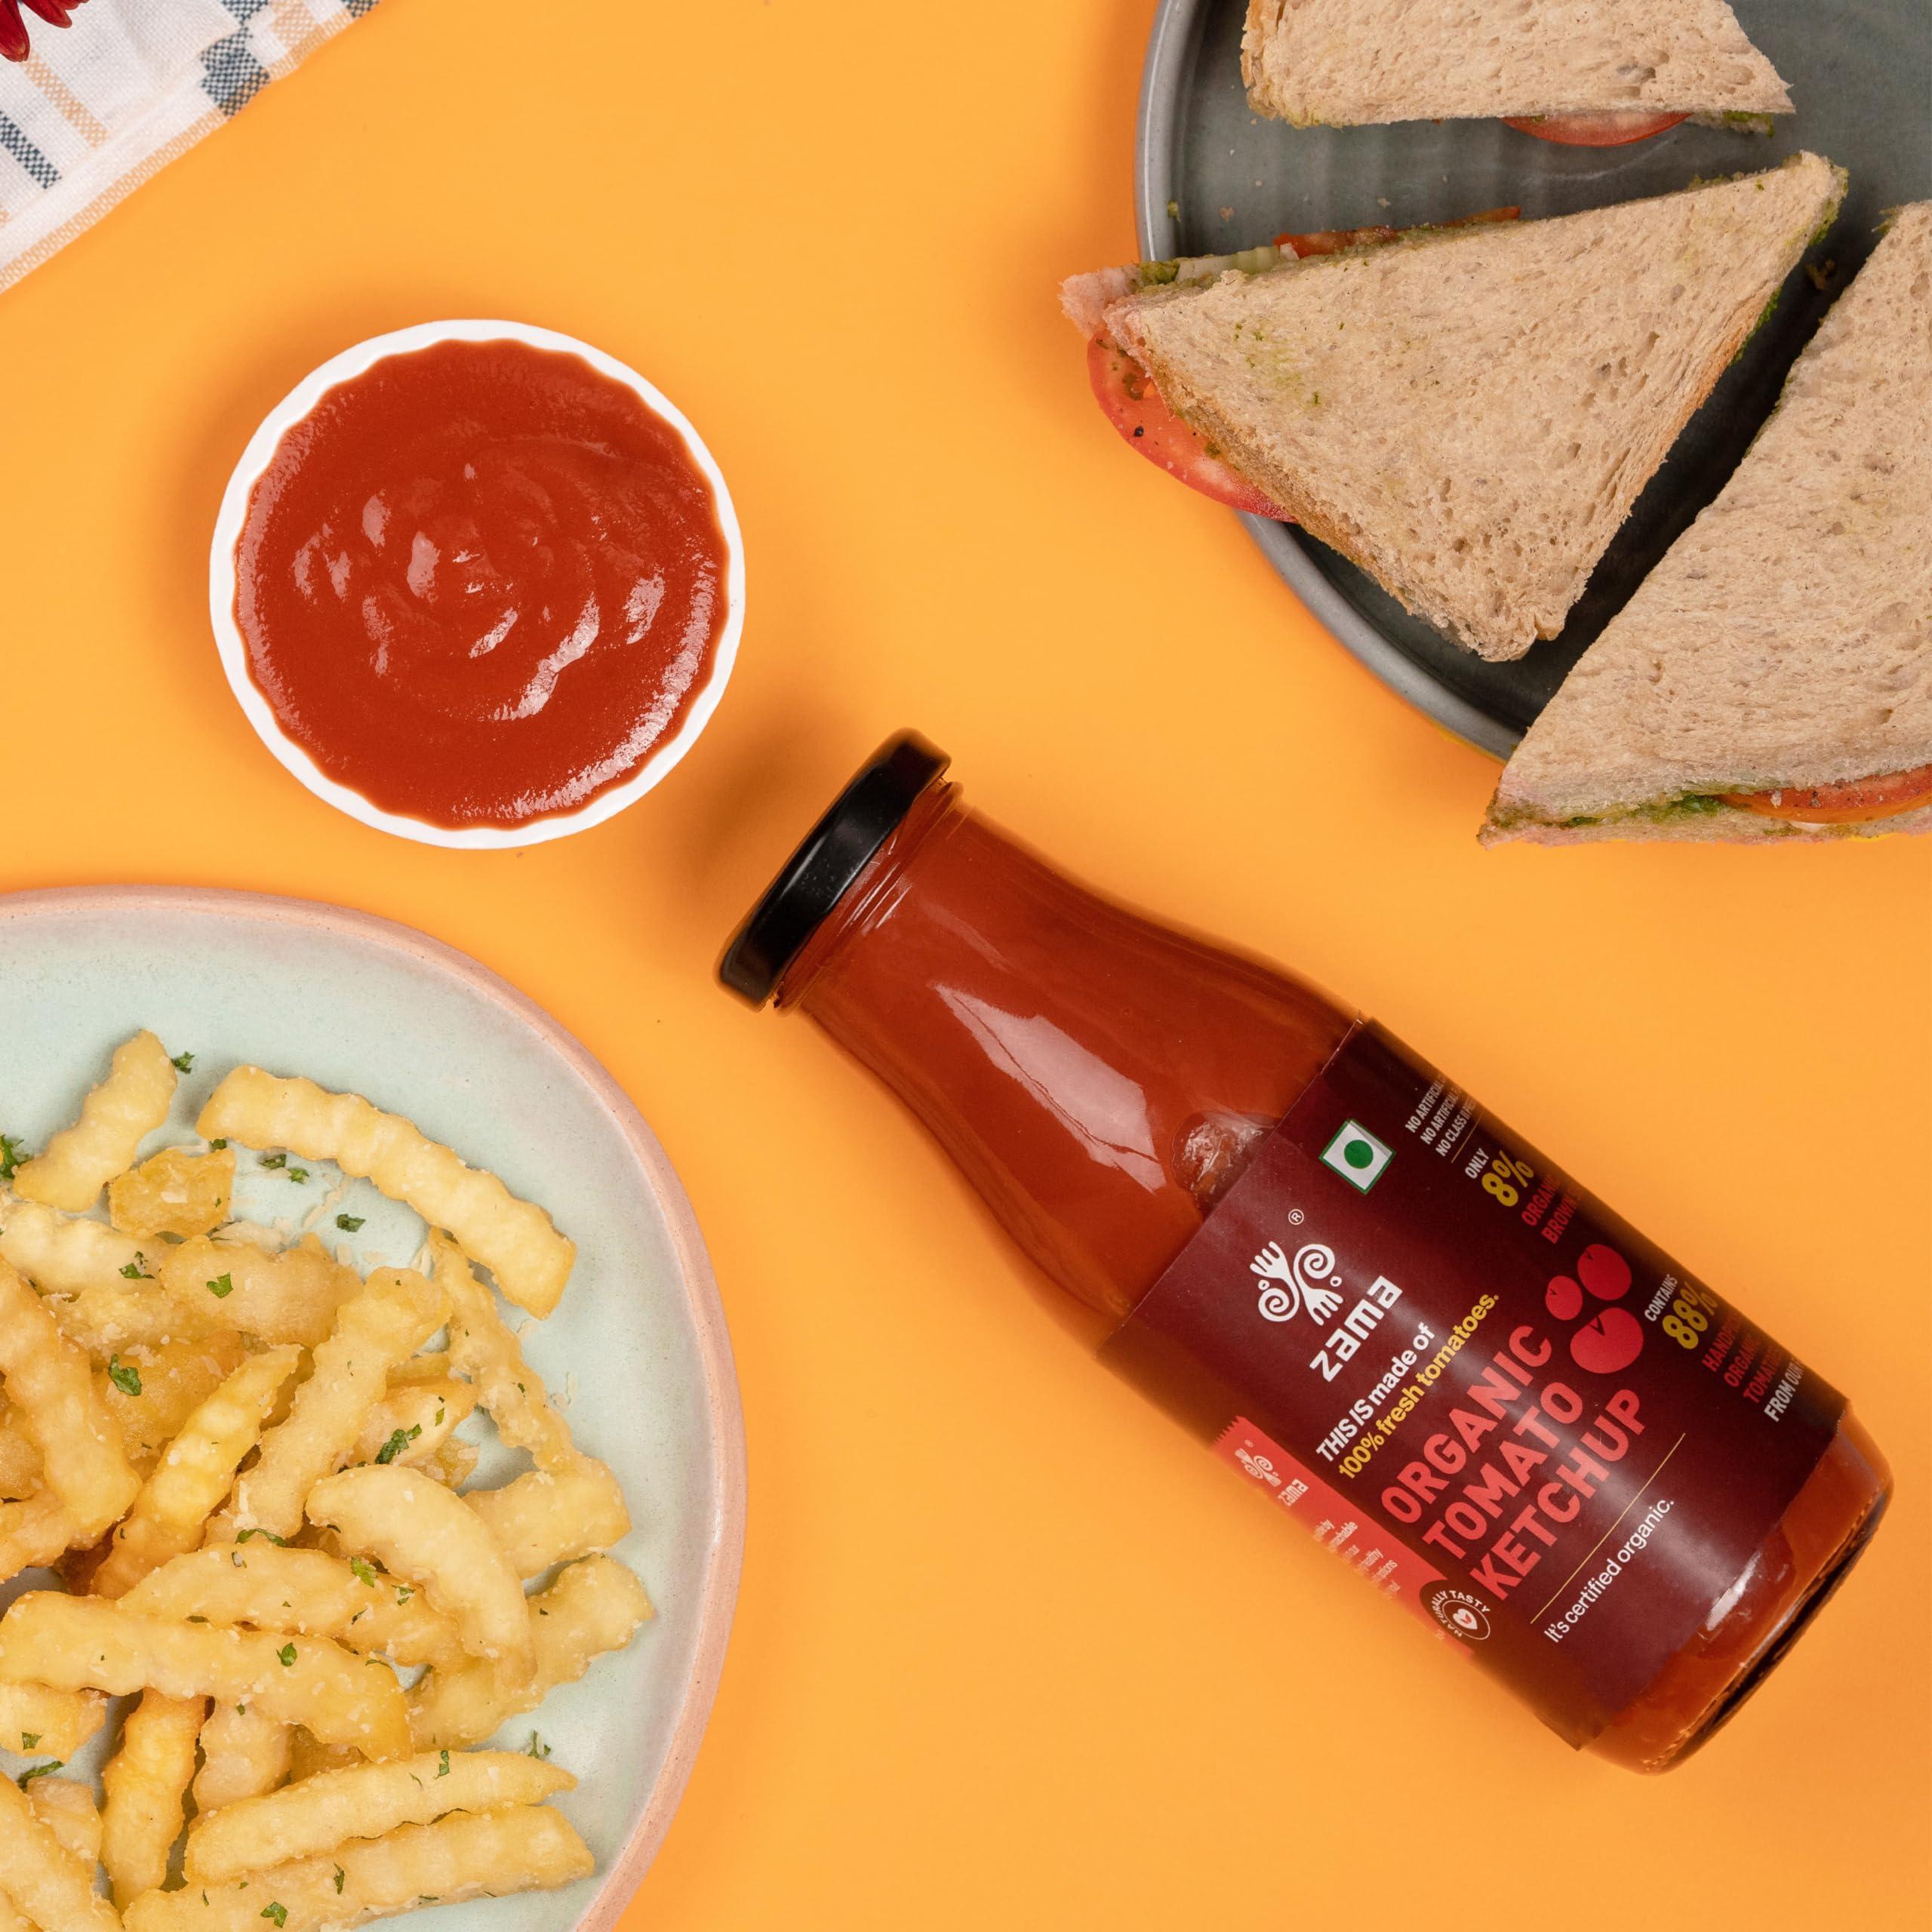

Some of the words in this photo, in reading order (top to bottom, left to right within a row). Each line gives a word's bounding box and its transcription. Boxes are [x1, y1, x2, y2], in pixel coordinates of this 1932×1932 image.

[1404, 1115, 1422, 1134] NO
[1416, 1079, 1445, 1121] ARTIFICIAL
[1420, 1127, 1437, 1146] NO
[1432, 1091, 1460, 1133] ARTIFICIAL
[1435, 1139, 1453, 1157] NO
[1447, 1115, 1469, 1143] CLASS
[1464, 1147, 1489, 1180] ONLY
[1481, 1149, 1534, 1207] 8%
[1644, 1273, 1678, 1321] CONTAINS
[1662, 1281, 1719, 1349] 88%
[1309, 1275, 1404, 1383] zama
[1315, 1418, 1358, 1462] THIS
[1349, 1398, 1374, 1426] IS
[1367, 1349, 1417, 1406] made
[1413, 1321, 1435, 1351] of
[1339, 1432, 1385, 1479] 100%
[1375, 1384, 1425, 1436] fresh
[1415, 1294, 1500, 1387] tomatoes.
[1763, 1379, 1797, 1423] FROM
[1784, 1360, 1804, 1386] OUR
[1381, 1325, 1552, 1524] ORGANIC
[1277, 1478, 1309, 1507] zama
[1422, 1381, 1583, 1560] TOMATO
[1469, 1389, 1645, 1601] KETCHUP
[1448, 1589, 1491, 1613] TASTY
[1544, 1620, 1571, 1643] It's
[1565, 1558, 1622, 1623] certified
[1617, 1500, 1675, 1564] organic.
